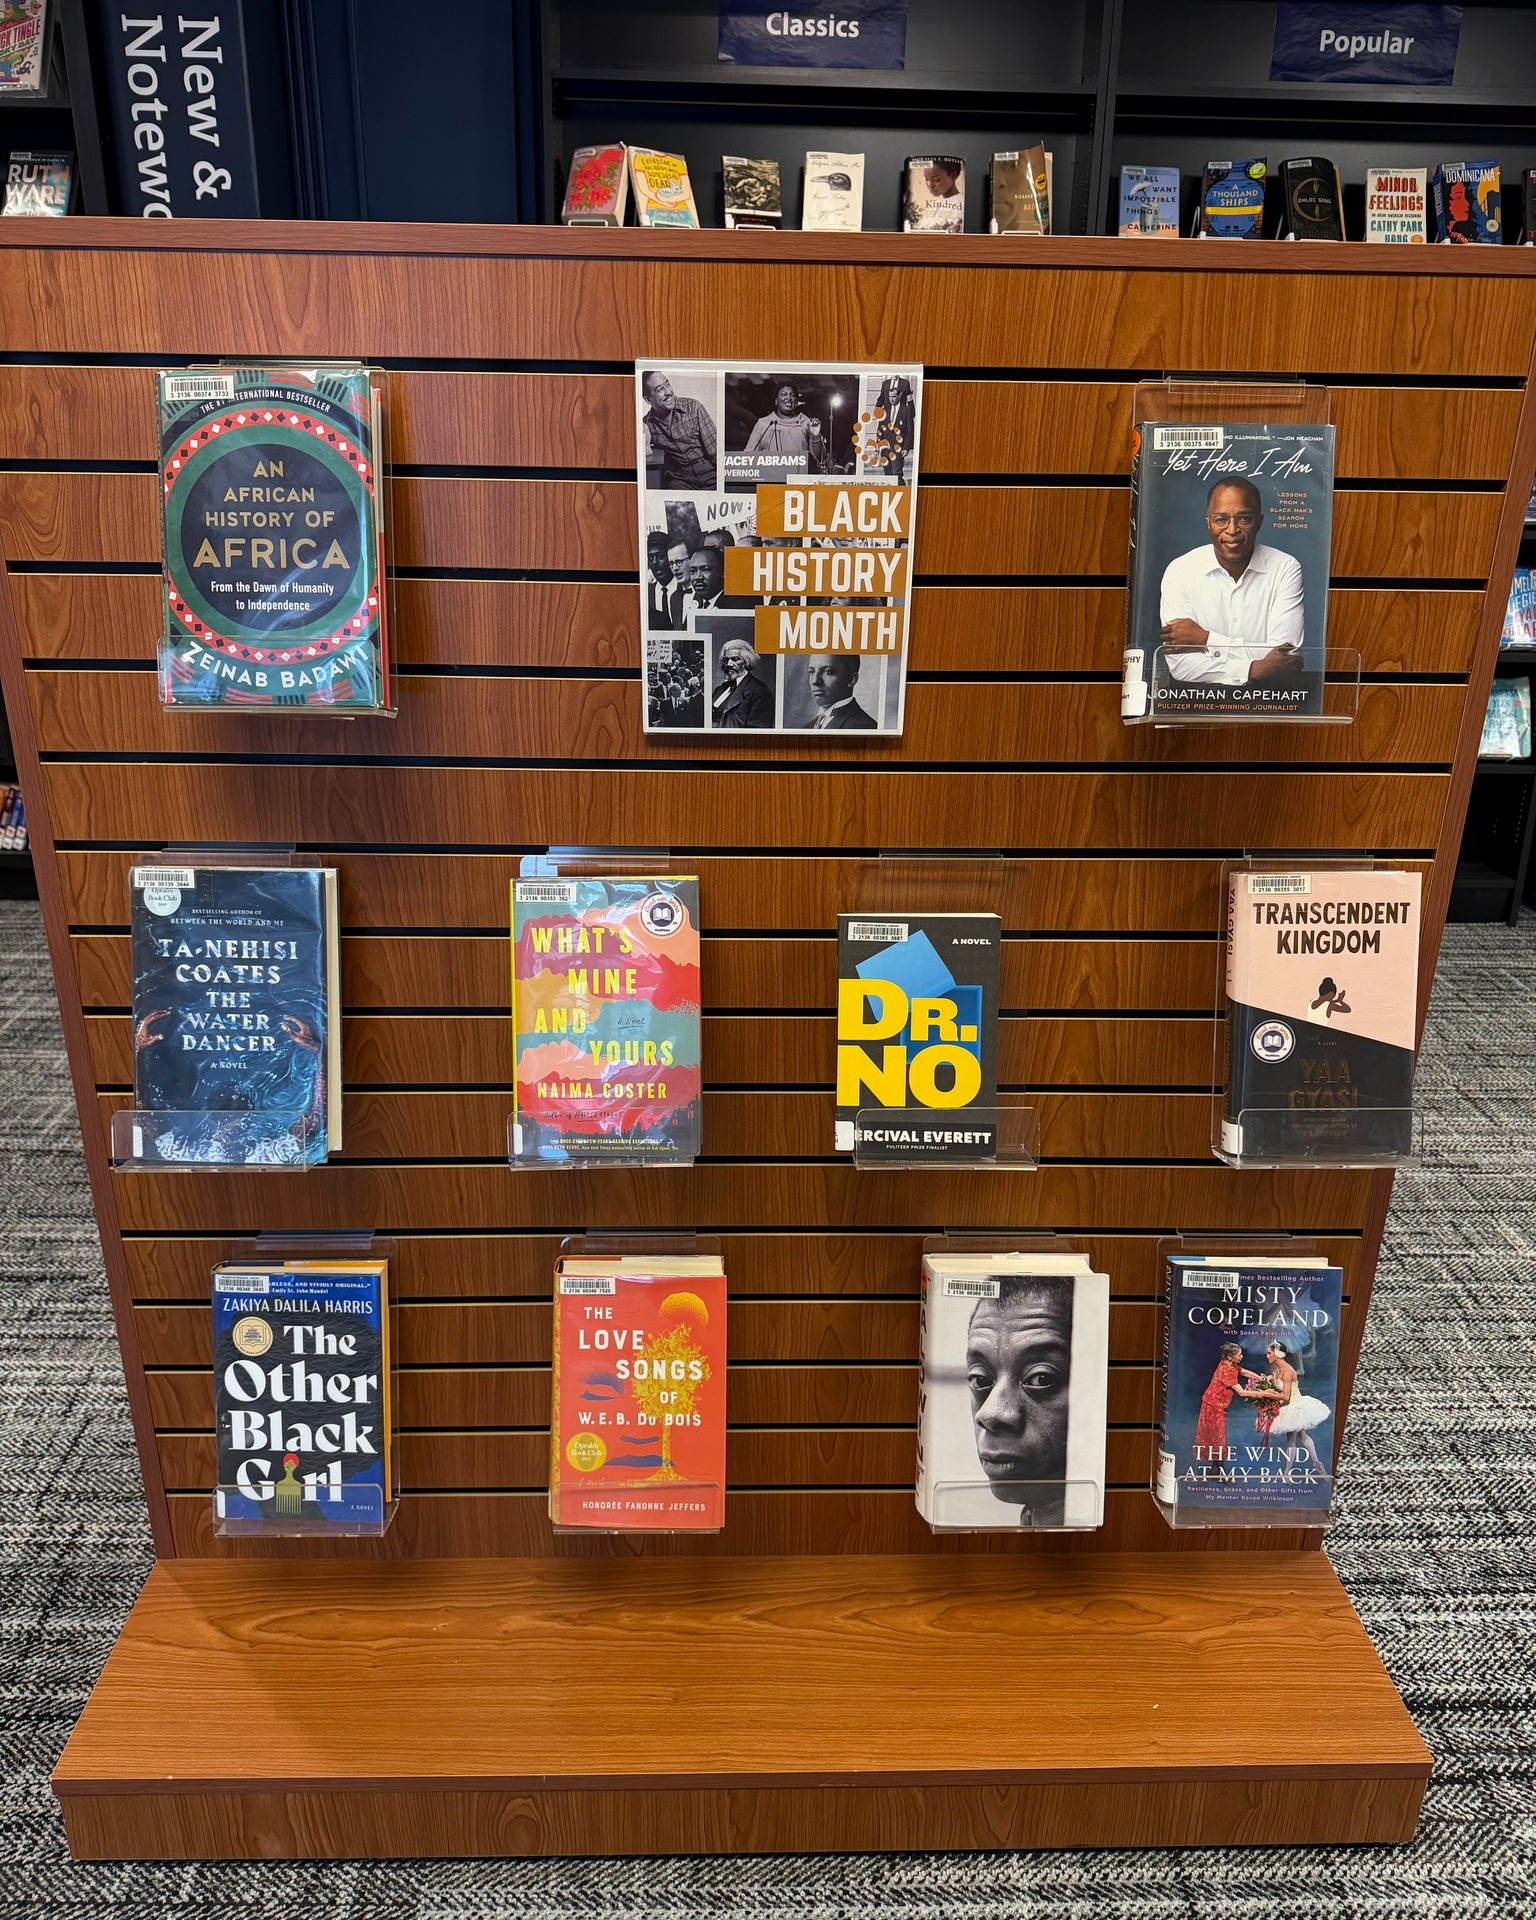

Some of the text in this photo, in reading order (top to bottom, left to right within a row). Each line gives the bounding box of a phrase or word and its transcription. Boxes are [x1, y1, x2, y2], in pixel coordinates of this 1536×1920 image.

[13, 19, 41, 44] TINGLE
[766, 12, 860, 39] Classics
[1319, 28, 1414, 58] Popular
[178, 15, 232, 201] New &
[8, 163, 70, 184] RUTH
[1446, 168, 1495, 184] DOMINICANA
[649, 178, 671, 189] DEAD
[1375, 176, 1418, 193] MINOR
[5, 184, 67, 205] WARE
[1123, 195, 1177, 204] IMPOSSIBLE
[1213, 190, 1258, 198] THOUSAND
[1220, 198, 1249, 206] SHIPS
[1368, 195, 1424, 211] FEELINGS
[925, 200, 963, 211] Kindred
[1126, 207, 1159, 215] THINGS
[1127, 223, 1177, 231] CATHERINE
[1371, 220, 1423, 232] CATHY PARK
[1385, 234, 1408, 243] HONG
[200, 391, 331, 414] THE BESTSELLER
[253, 461, 284, 477] AN
[757, 455, 806, 466] ABRAMS
[1163, 444, 1314, 481] Yet Here I Am
[223, 488, 315, 503] AFRICAN
[205, 510, 335, 528] HISTORY OF
[784, 490, 904, 533] BLACK
[193, 538, 350, 569] AFRICA
[753, 551, 903, 593] HISTORY
[211, 581, 335, 596] From the Dawn of Humanity
[235, 600, 311, 612] to Independence
[779, 610, 898, 650] MONTH
[182, 641, 370, 688] ZEINAB BADAWI
[1147, 688, 1309, 701] JONATHAN CAPEHART
[1157, 702, 1191, 710] PULITZER
[1193, 703, 1250, 711] PRIZE-WINNING
[1253, 902, 1411, 925] TRANSCENDENT
[157, 938, 298, 960] TA-NEHISI
[531, 928, 633, 953] WHAT'S
[1276, 930, 1381, 954] KINGDOM
[176, 964, 281, 984] COATES
[568, 969, 638, 994] MINE
[206, 991, 251, 1008] THE
[838, 978, 977, 1042] DR.
[187, 1013, 270, 1030] WATER
[534, 1009, 586, 1034] AND
[625, 1017, 645, 1025] Novel
[182, 1034, 276, 1052] DANCER
[589, 1040, 674, 1066] YOURS
[837, 1044, 981, 1109] NO
[1300, 1058, 1351, 1084] YAA
[537, 1082, 667, 1098] NAIMA COSTER
[1288, 1086, 1359, 1112] GYASI
[855, 1130, 991, 1144] ERCIVAL EVERETT
[1257, 1275, 1297, 1283] Bestselling
[1222, 1286, 1302, 1304] MISTY
[223, 1298, 373, 1314] ZAKIYA DALILA HARRIS
[584, 1306, 613, 1320] THE
[1188, 1307, 1329, 1328] COPELAND
[283, 1325, 358, 1356] The
[579, 1329, 645, 1350] LOVE
[616, 1359, 703, 1380] SONGS
[224, 1359, 378, 1404] Other
[659, 1391, 678, 1404] OF
[665, 1413, 702, 1426] BOIS
[227, 1409, 378, 1454] Black
[1193, 1446, 1310, 1463] THE WIND
[1183, 1466, 1318, 1485] AT MY BACK
[582, 1499, 706, 1511] HONORÉE FANONNE JEFFERS
